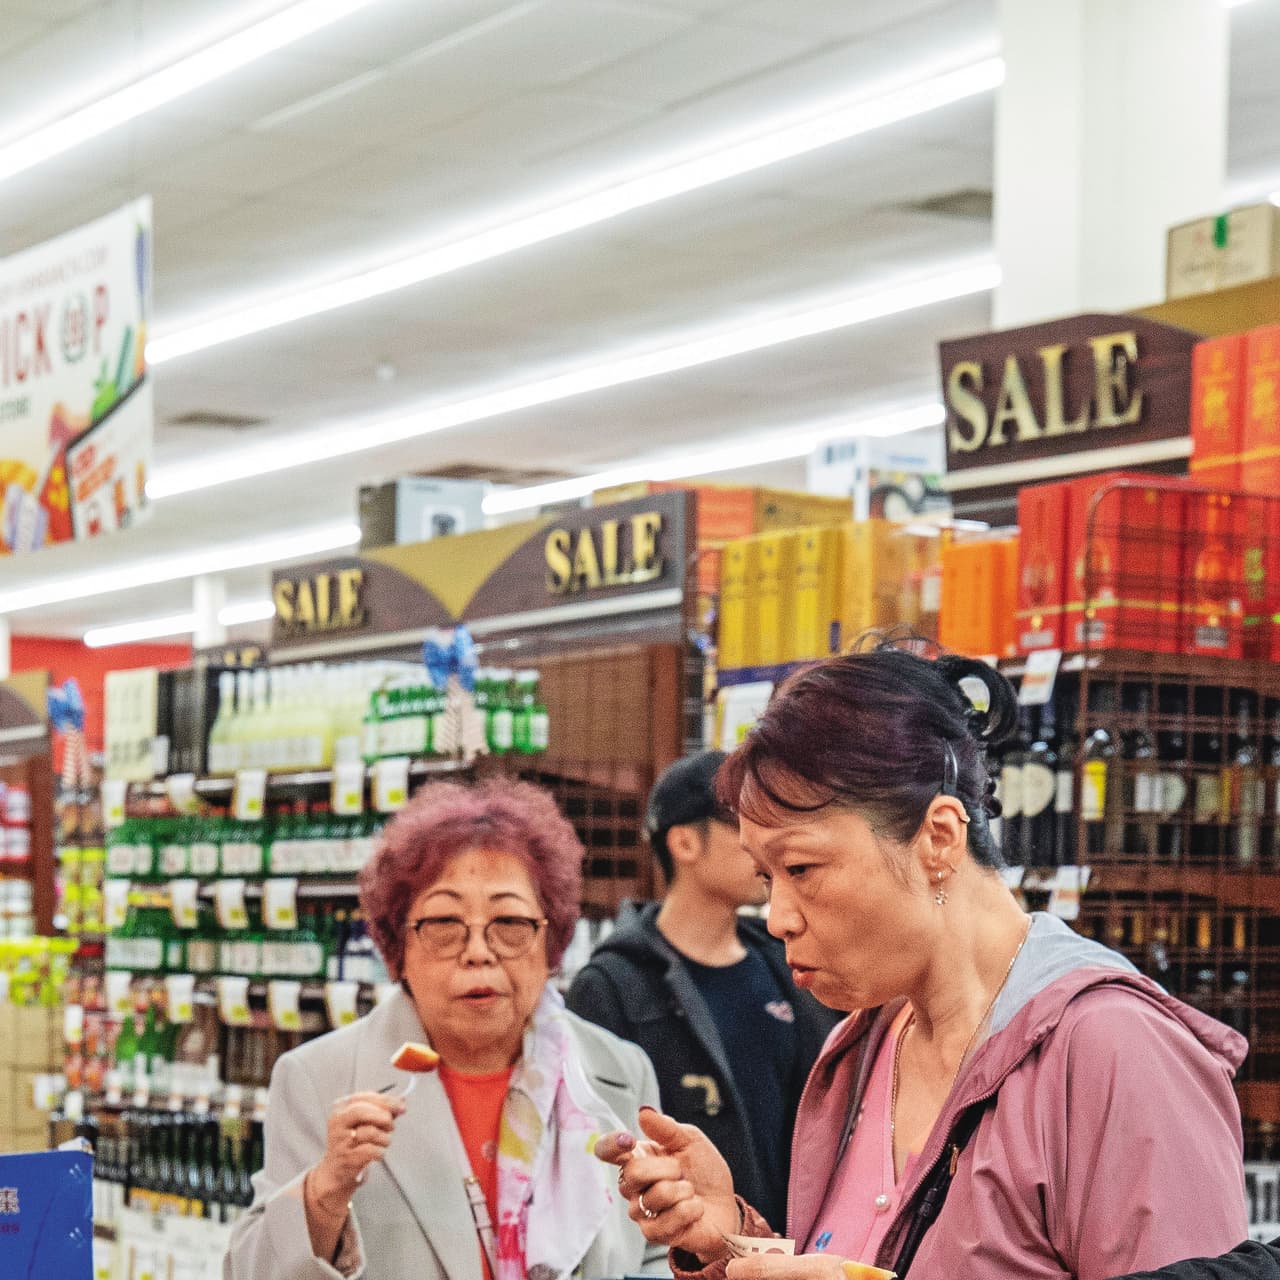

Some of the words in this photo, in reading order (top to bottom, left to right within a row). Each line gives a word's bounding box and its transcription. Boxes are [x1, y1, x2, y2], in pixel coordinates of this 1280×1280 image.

[945, 331, 1144, 454] SALE
[544, 511, 664, 595] SALE
[273, 567, 367, 632] SALE
